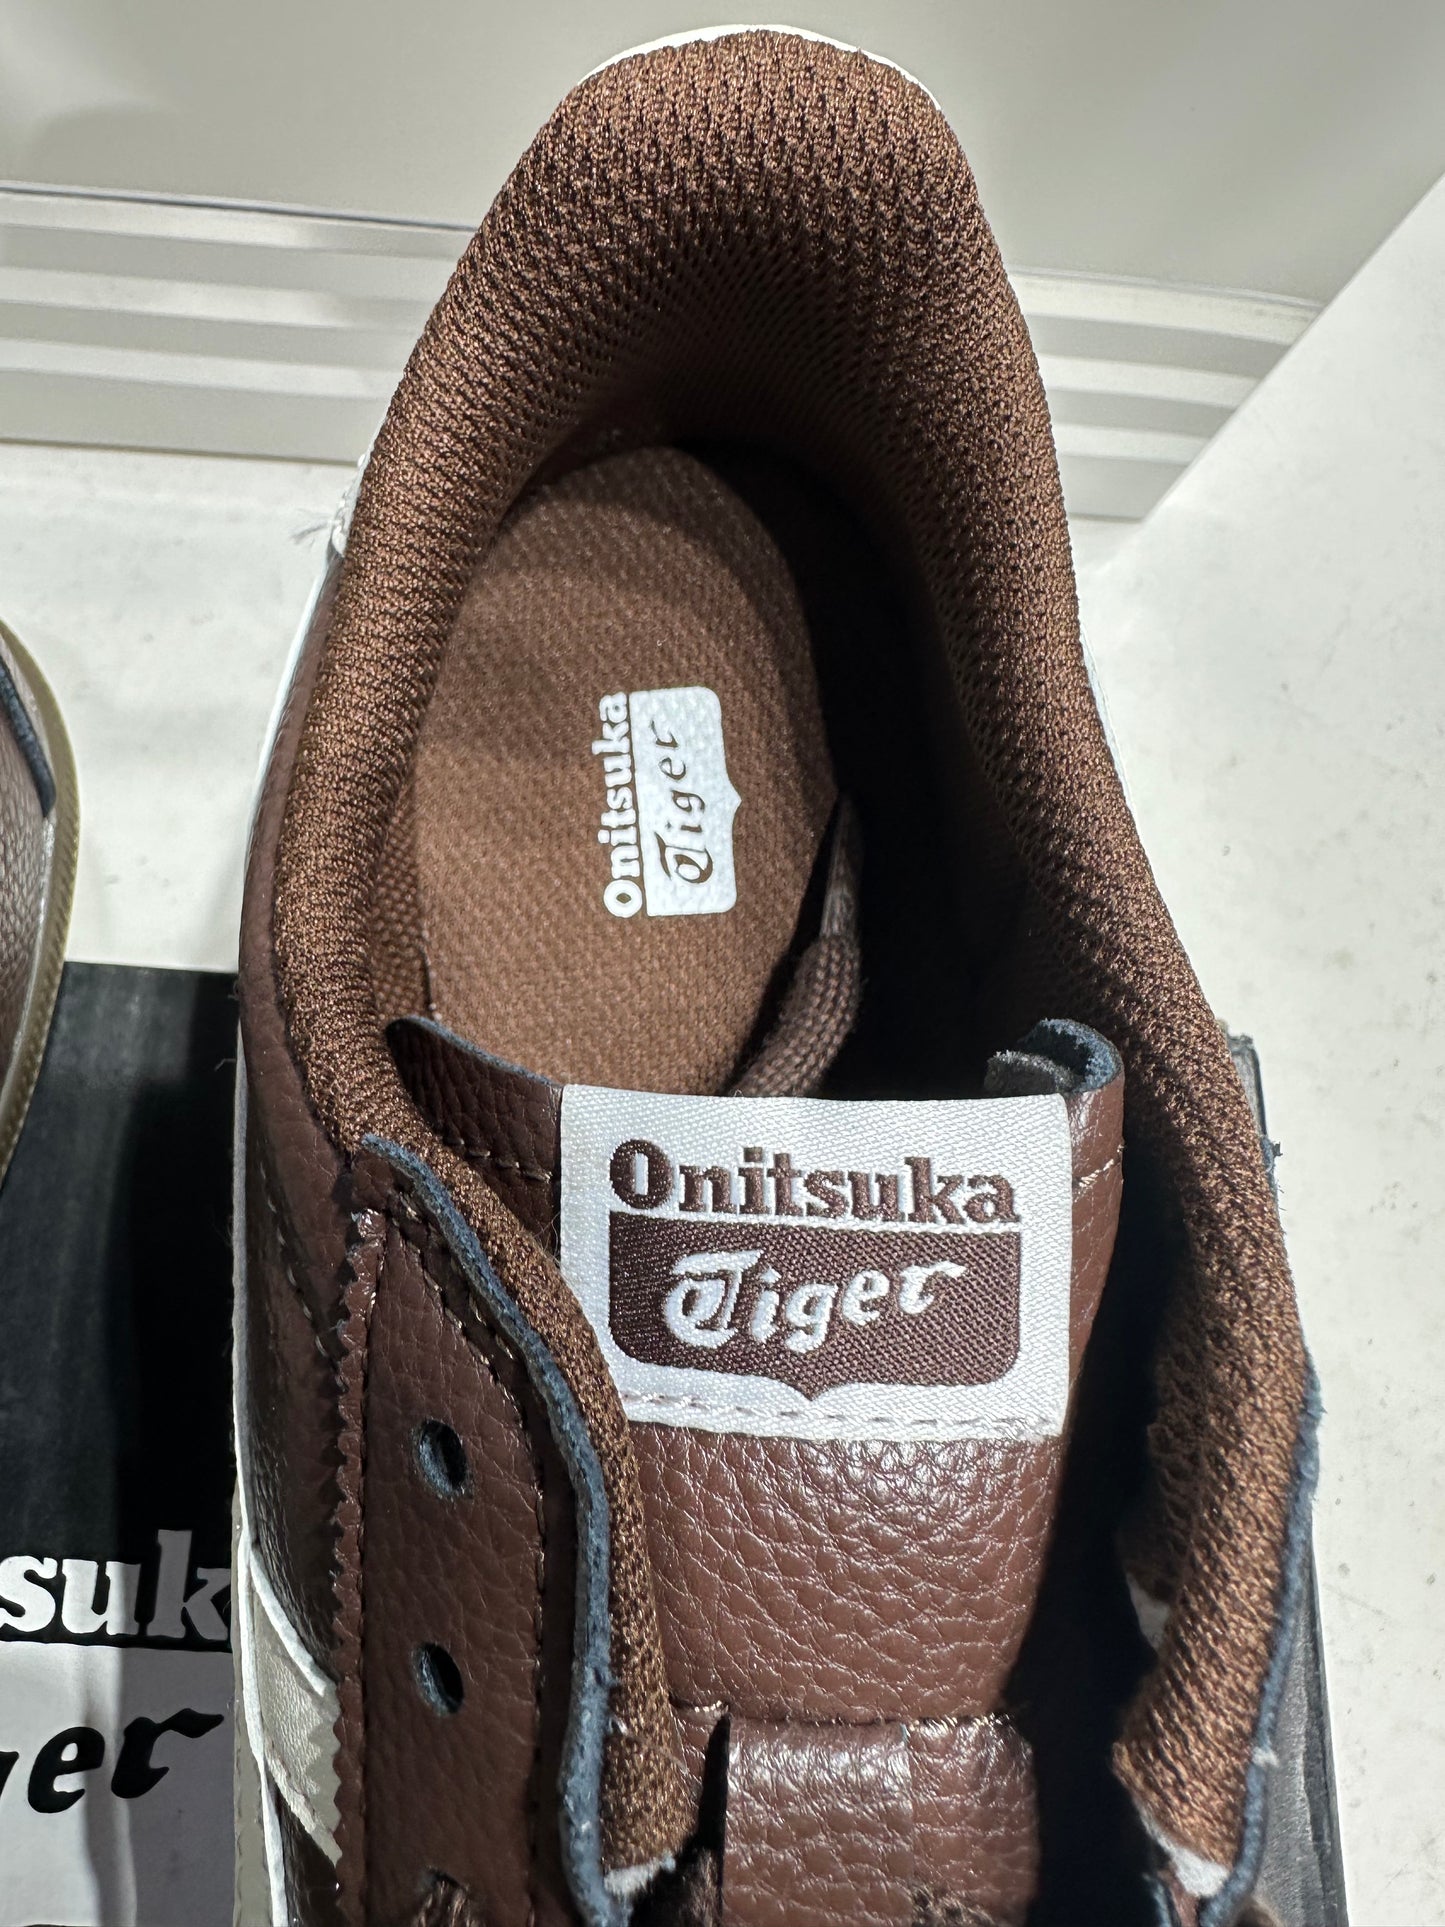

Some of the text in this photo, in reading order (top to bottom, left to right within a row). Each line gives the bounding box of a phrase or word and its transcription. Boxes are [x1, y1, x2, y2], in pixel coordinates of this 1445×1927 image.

[592, 692, 643, 918] Onitsuka
[650, 720, 713, 885] Tiger
[609, 1138, 1022, 1225] Onitsuka
[664, 1248, 968, 1353] Tiger
[0, 1707, 225, 1814] er
